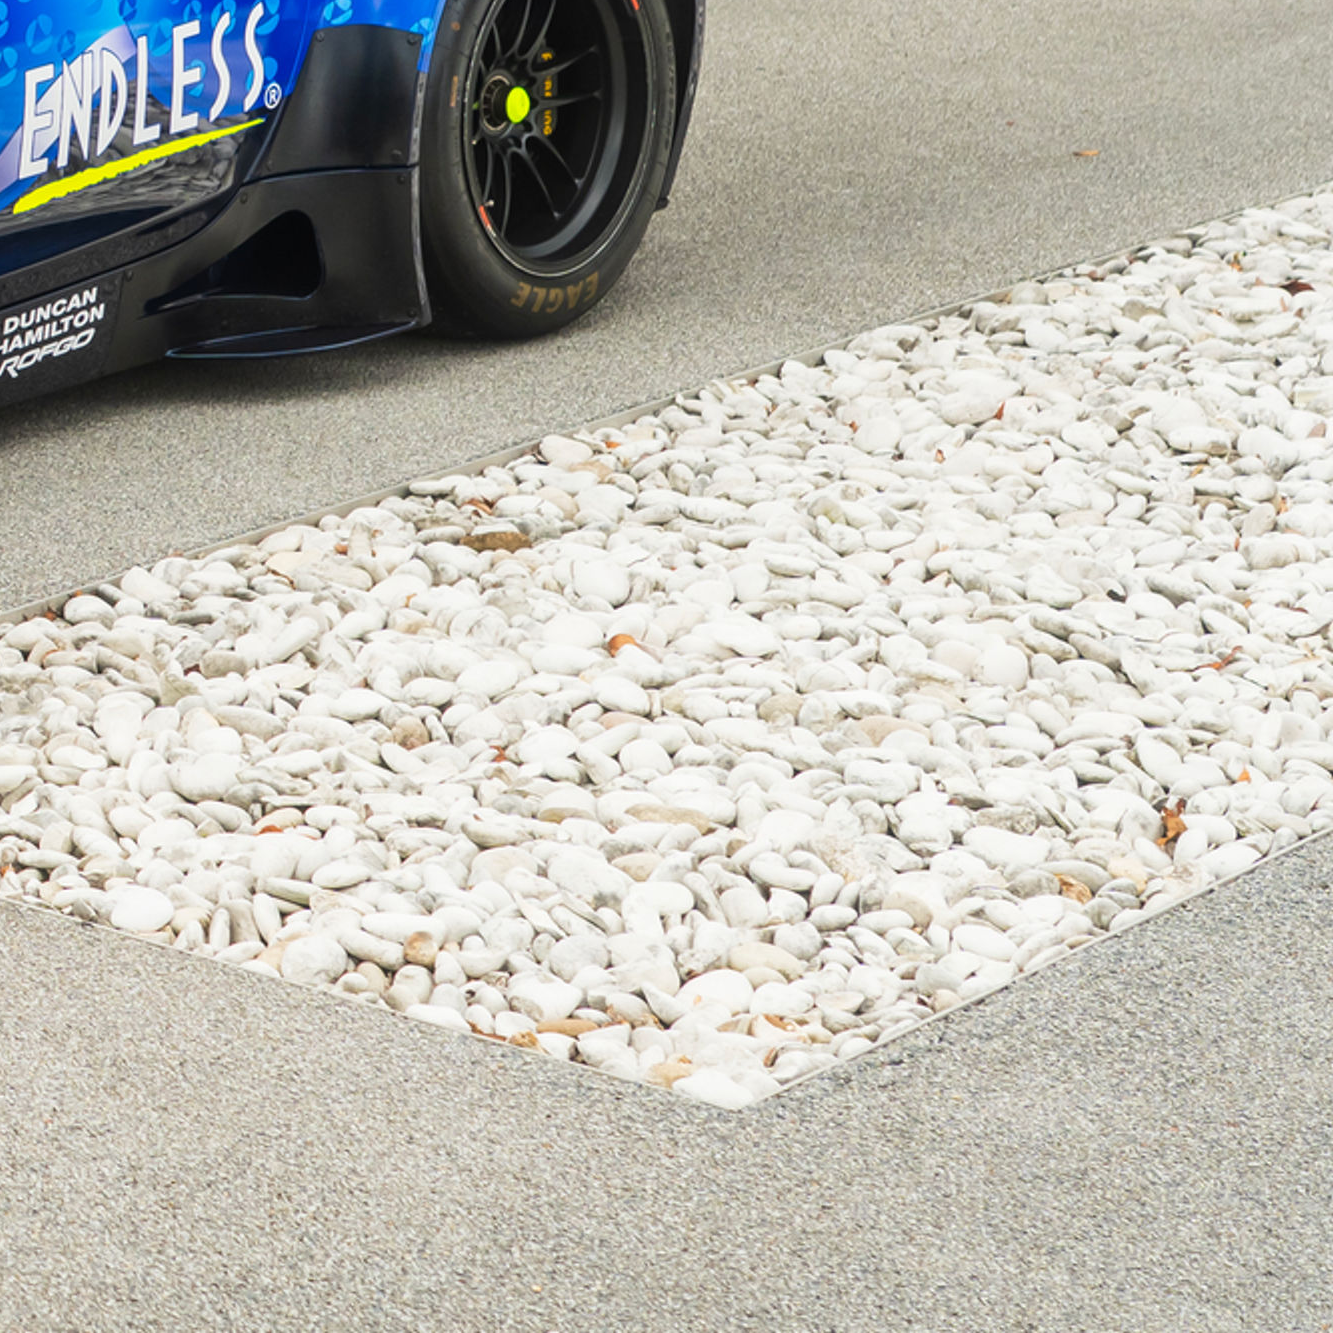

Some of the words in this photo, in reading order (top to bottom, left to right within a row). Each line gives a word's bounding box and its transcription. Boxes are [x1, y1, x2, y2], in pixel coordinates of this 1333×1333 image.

[18, 2, 266, 182] ENDLESS
[2, 287, 99, 335] DUNCAN
[510, 270, 600, 314] EAGLE
